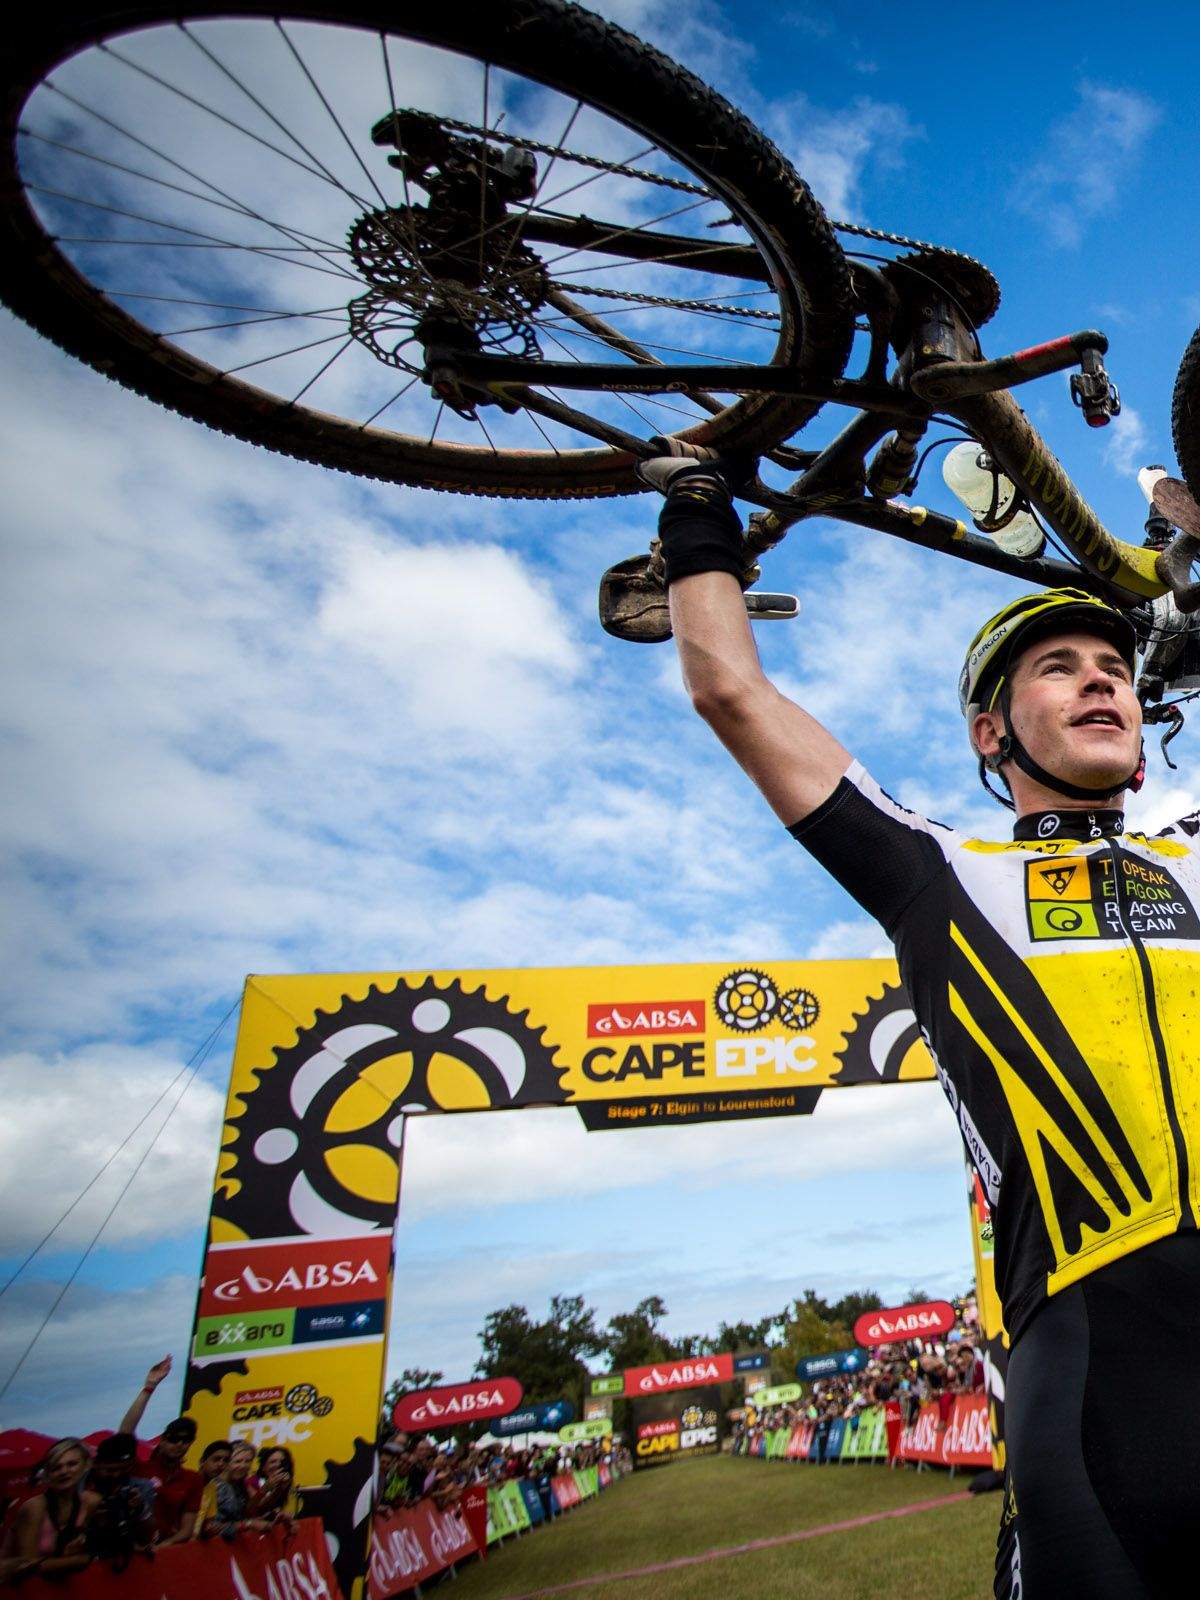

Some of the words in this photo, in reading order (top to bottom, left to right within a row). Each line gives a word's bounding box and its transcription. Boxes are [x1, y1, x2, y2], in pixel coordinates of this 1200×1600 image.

[977, 627, 1007, 657] ERGON
[1098, 858, 1171, 885] TOPEAK
[1103, 880, 1172, 901] ERGON
[1105, 901, 1187, 918] RACING
[1107, 918, 1177, 933] TEAM
[632, 1009, 699, 1030] ABSA
[581, 1041, 706, 1083] CAPE
[716, 1035, 818, 1077] EPIC
[607, 1104, 646, 1119] Stage
[650, 1104, 664, 1117] 7:
[666, 1100, 700, 1116] Elgin
[703, 1101, 716, 1112] to
[274, 1259, 380, 1293] ABSA
[894, 1311, 942, 1332] ABSA
[204, 1322, 286, 1347] exxaro
[668, 1362, 719, 1385] ABSA
[232, 1402, 282, 1421] CAPE
[445, 1389, 505, 1415] ABSA
[228, 1413, 314, 1447] EPIC
[637, 1432, 680, 1456] CAPE
[680, 1426, 718, 1449] EPIC
